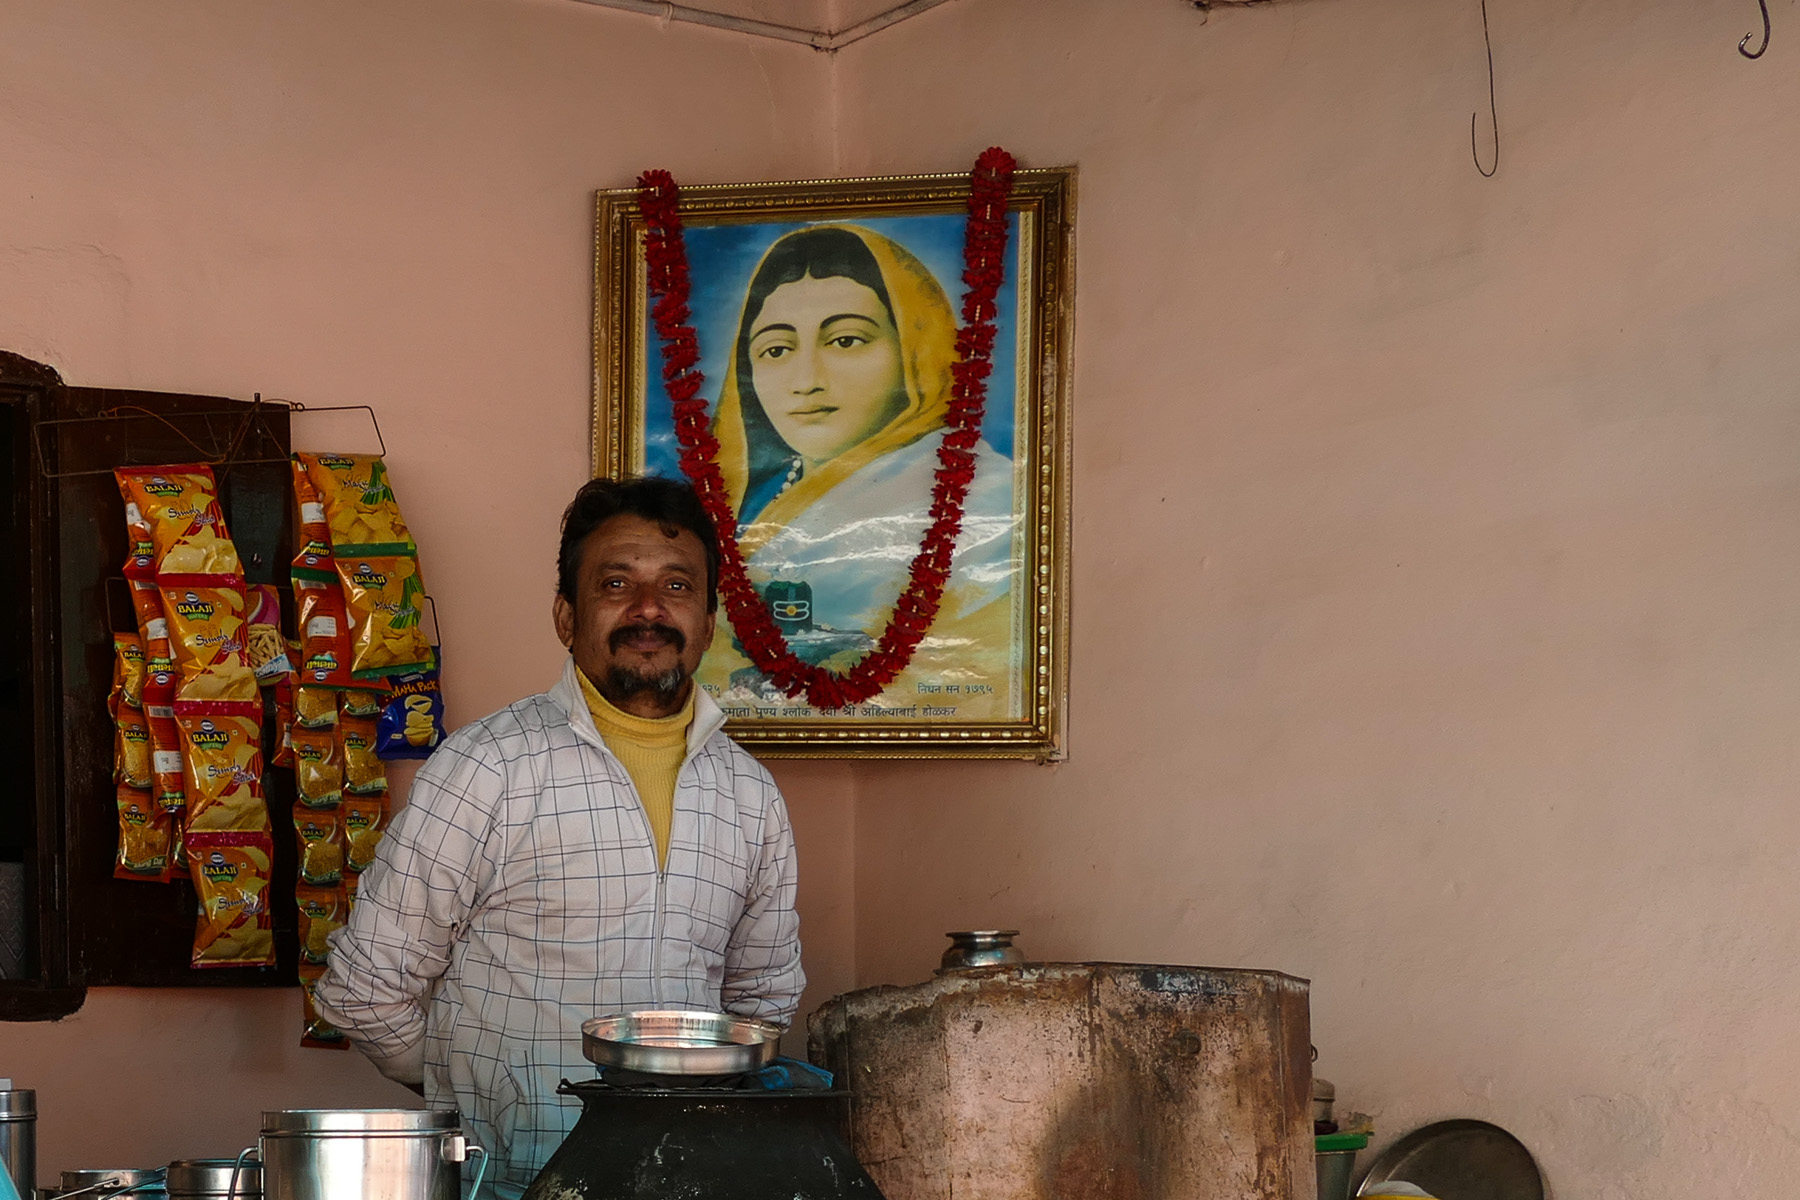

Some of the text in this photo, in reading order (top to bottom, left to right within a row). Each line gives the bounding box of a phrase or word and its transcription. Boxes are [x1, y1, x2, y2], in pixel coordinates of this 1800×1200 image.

[144, 484, 184, 493] BALAJI
[353, 574, 386, 585] BALAJI
[177, 603, 214, 614] BALAJI
[192, 732, 228, 744] BALAJI
